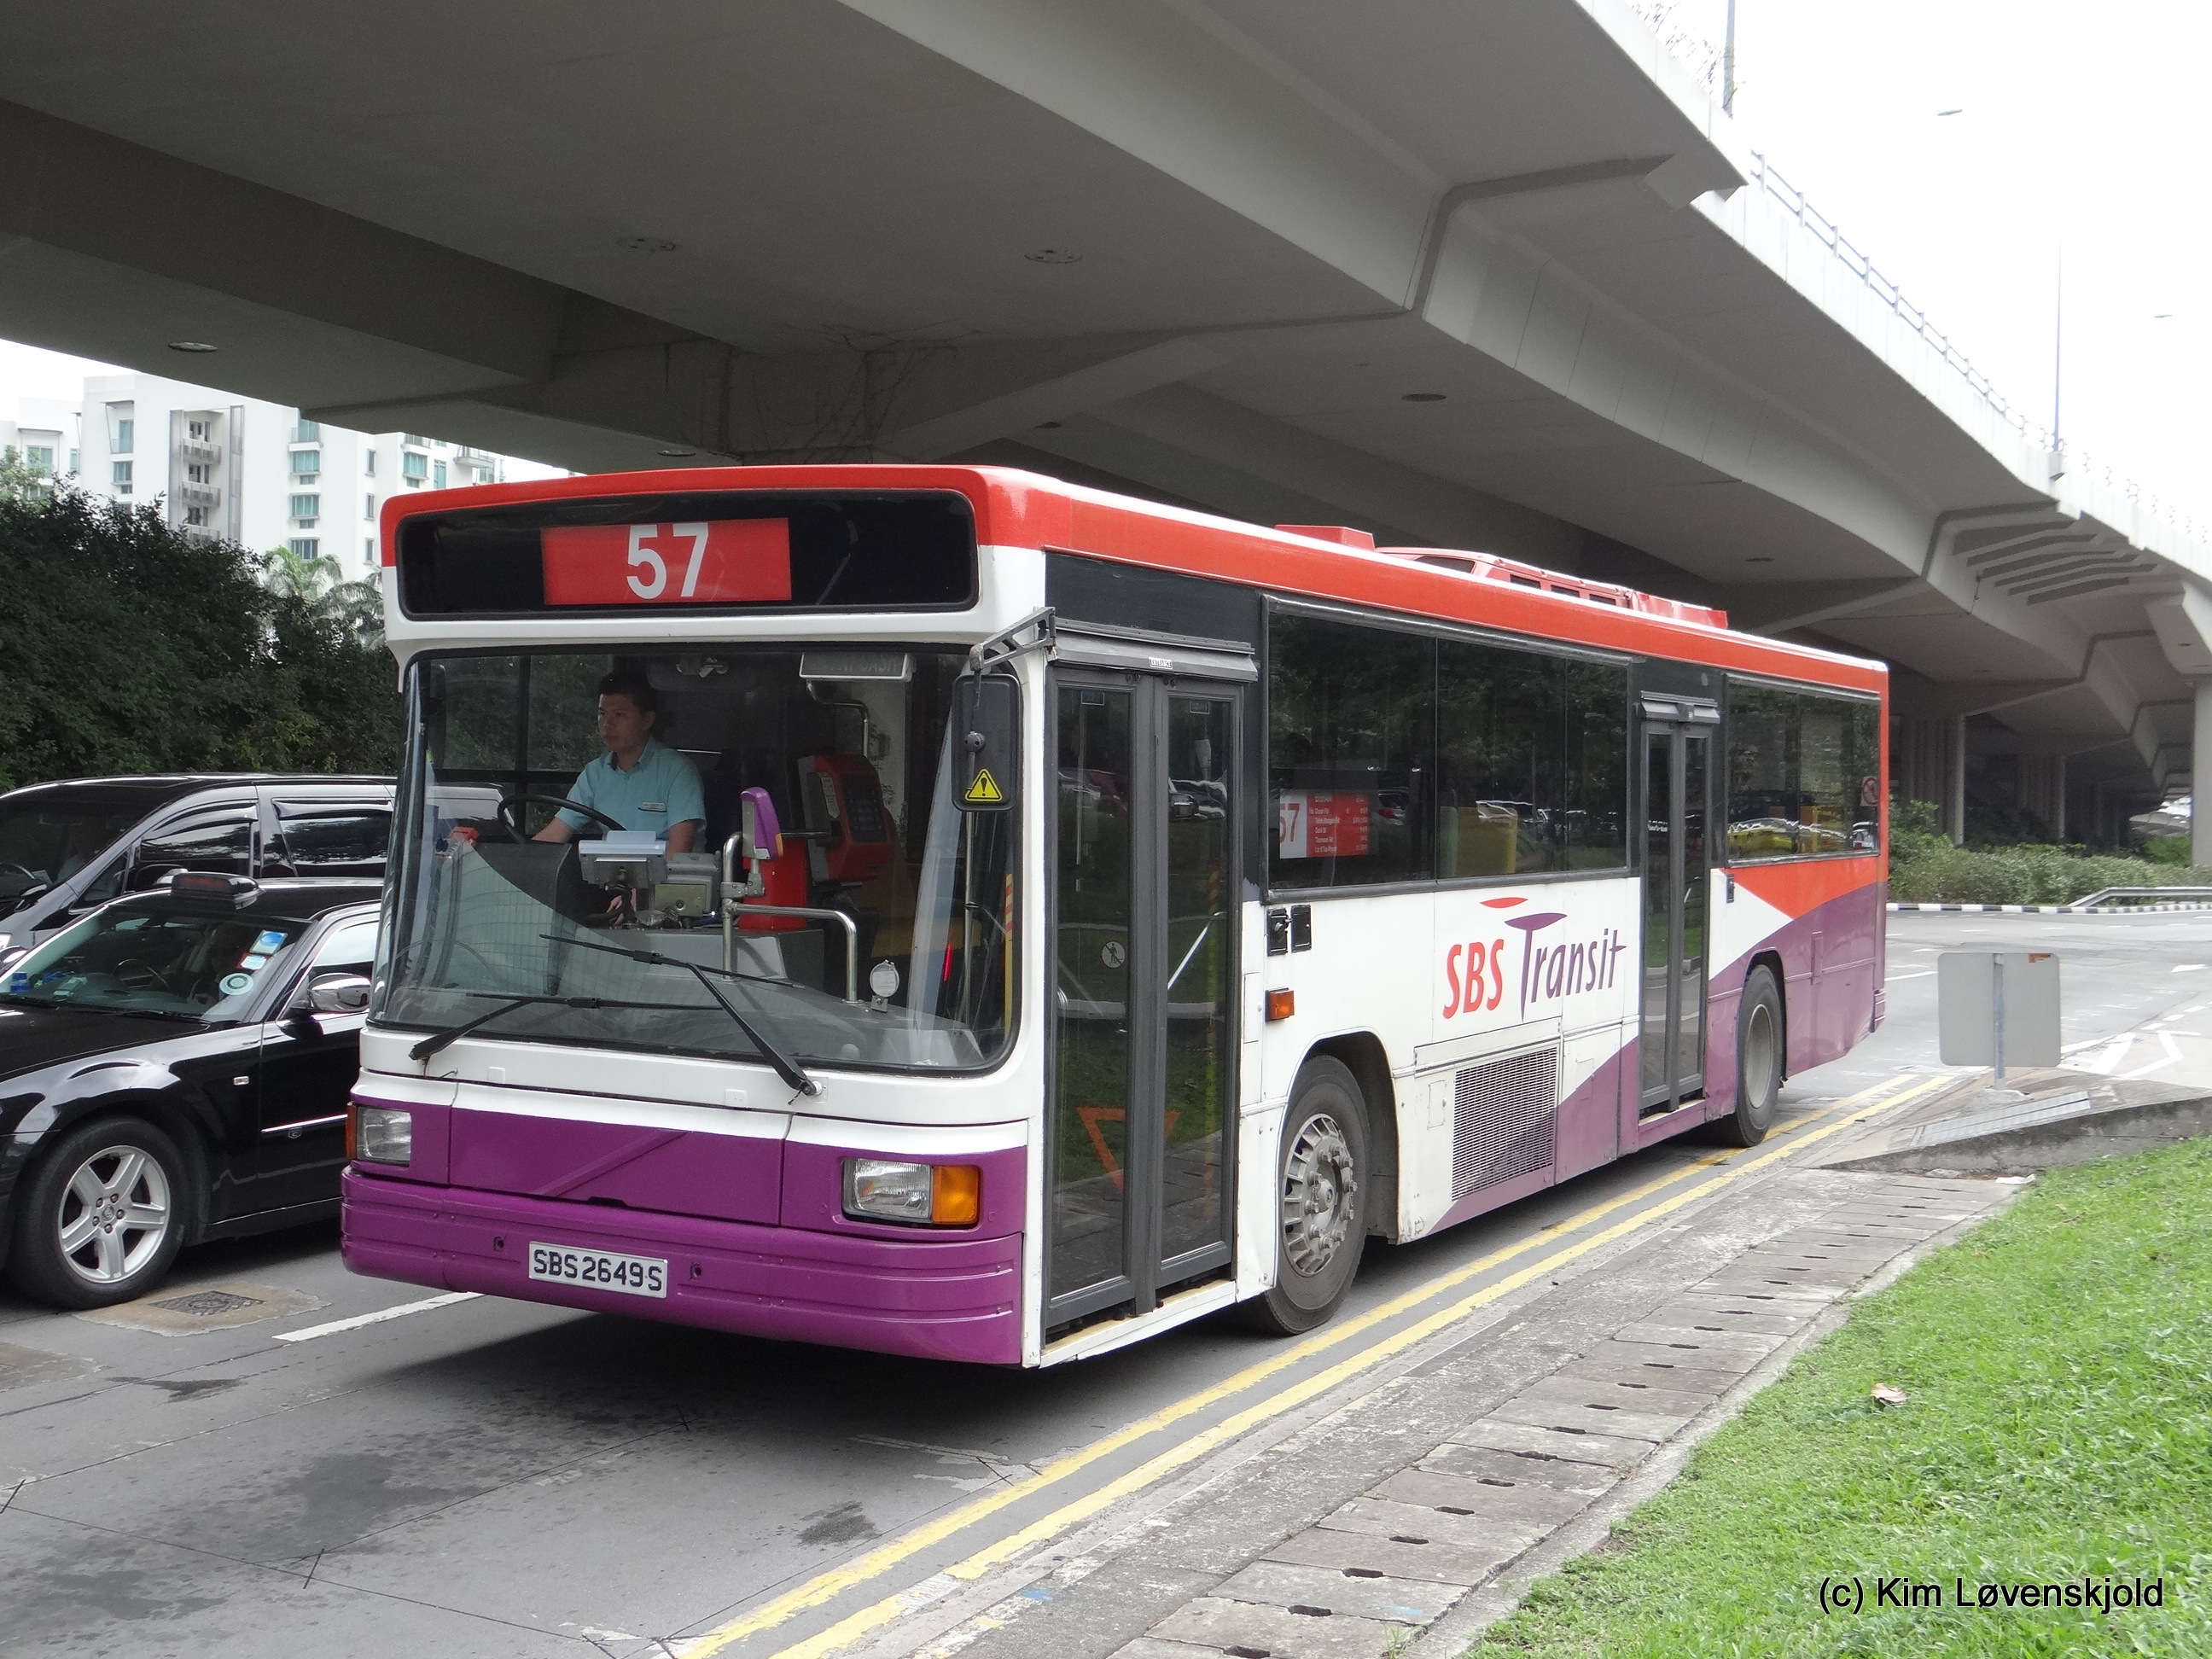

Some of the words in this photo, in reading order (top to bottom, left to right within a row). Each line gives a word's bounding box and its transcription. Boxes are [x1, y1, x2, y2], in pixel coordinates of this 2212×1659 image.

[626, 521, 709, 600] 57
[1442, 939, 1505, 1020] SBS
[1504, 912, 1627, 1024] Transit
[533, 1249, 662, 1292] SBS2649S
